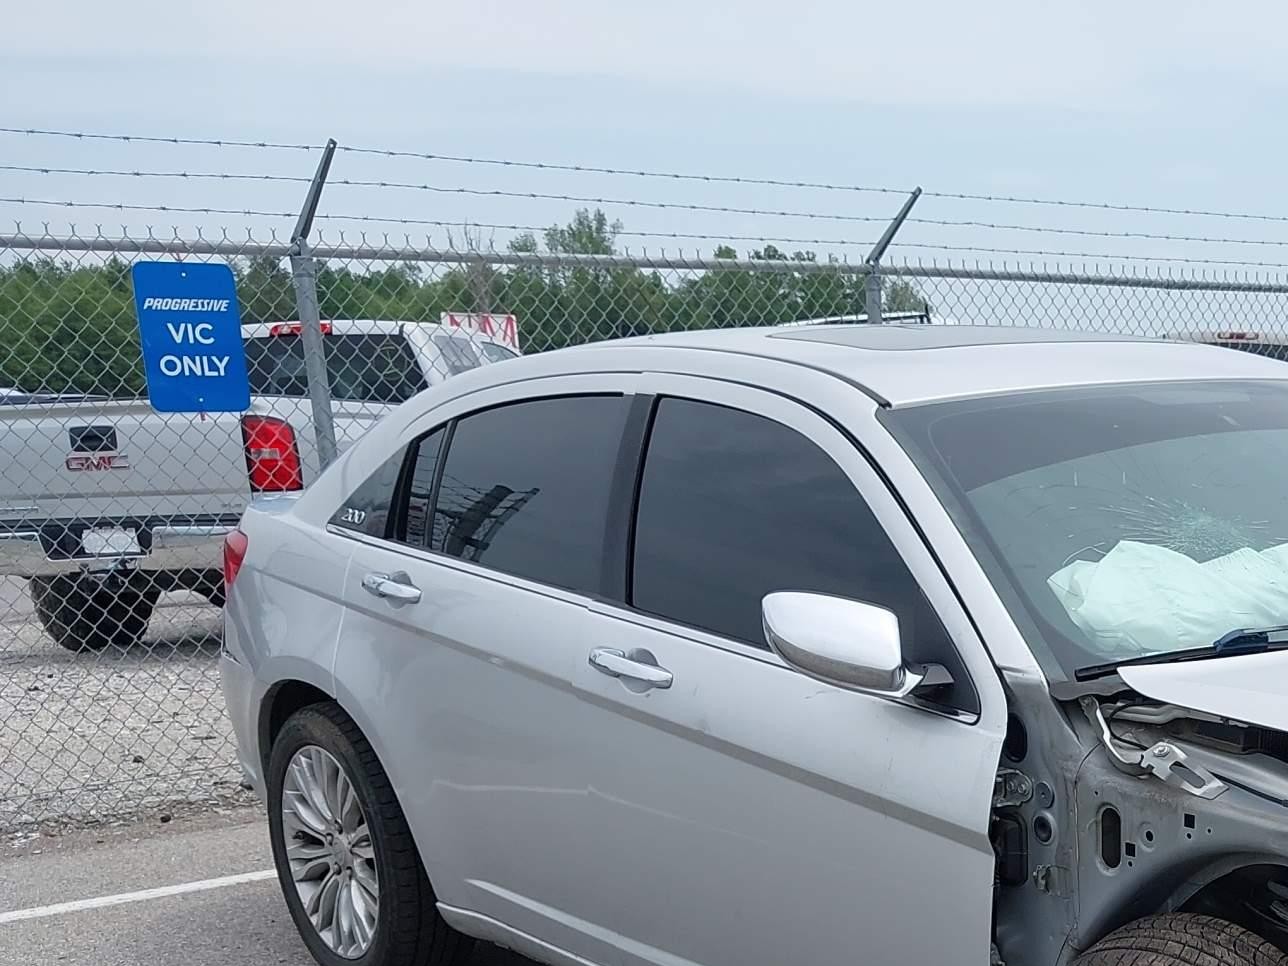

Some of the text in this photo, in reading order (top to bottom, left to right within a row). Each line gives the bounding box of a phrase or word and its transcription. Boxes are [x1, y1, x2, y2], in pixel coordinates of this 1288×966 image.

[143, 298, 230, 312] PROGRESSIVE
[166, 322, 215, 345] VIC
[159, 354, 230, 377] ONLY
[65, 454, 130, 472] GMC
[341, 508, 366, 524] 200
